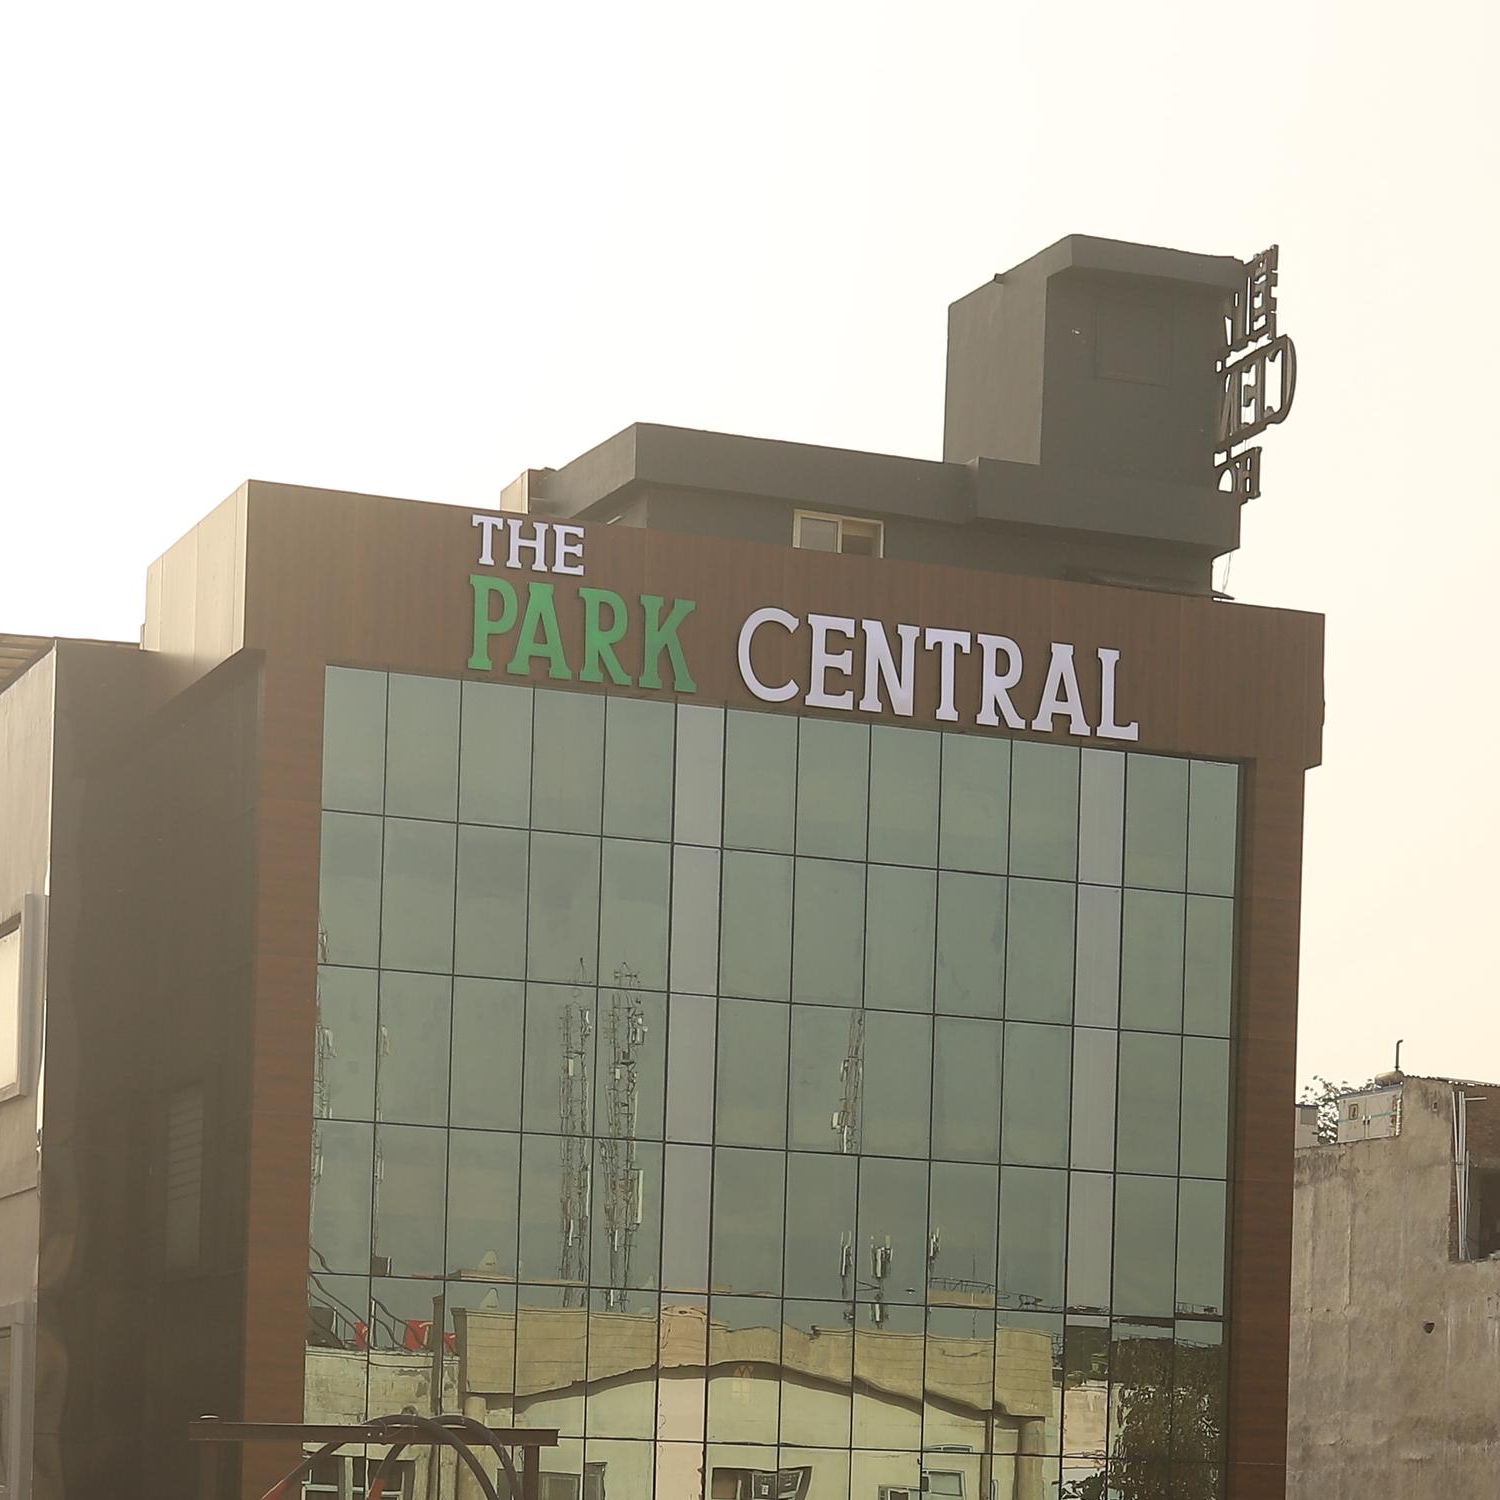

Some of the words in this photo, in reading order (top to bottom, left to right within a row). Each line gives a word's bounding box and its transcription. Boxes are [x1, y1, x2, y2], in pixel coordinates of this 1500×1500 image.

[470, 512, 585, 577] THE
[466, 574, 697, 694] PARK
[736, 606, 1140, 741] CENTRAL
